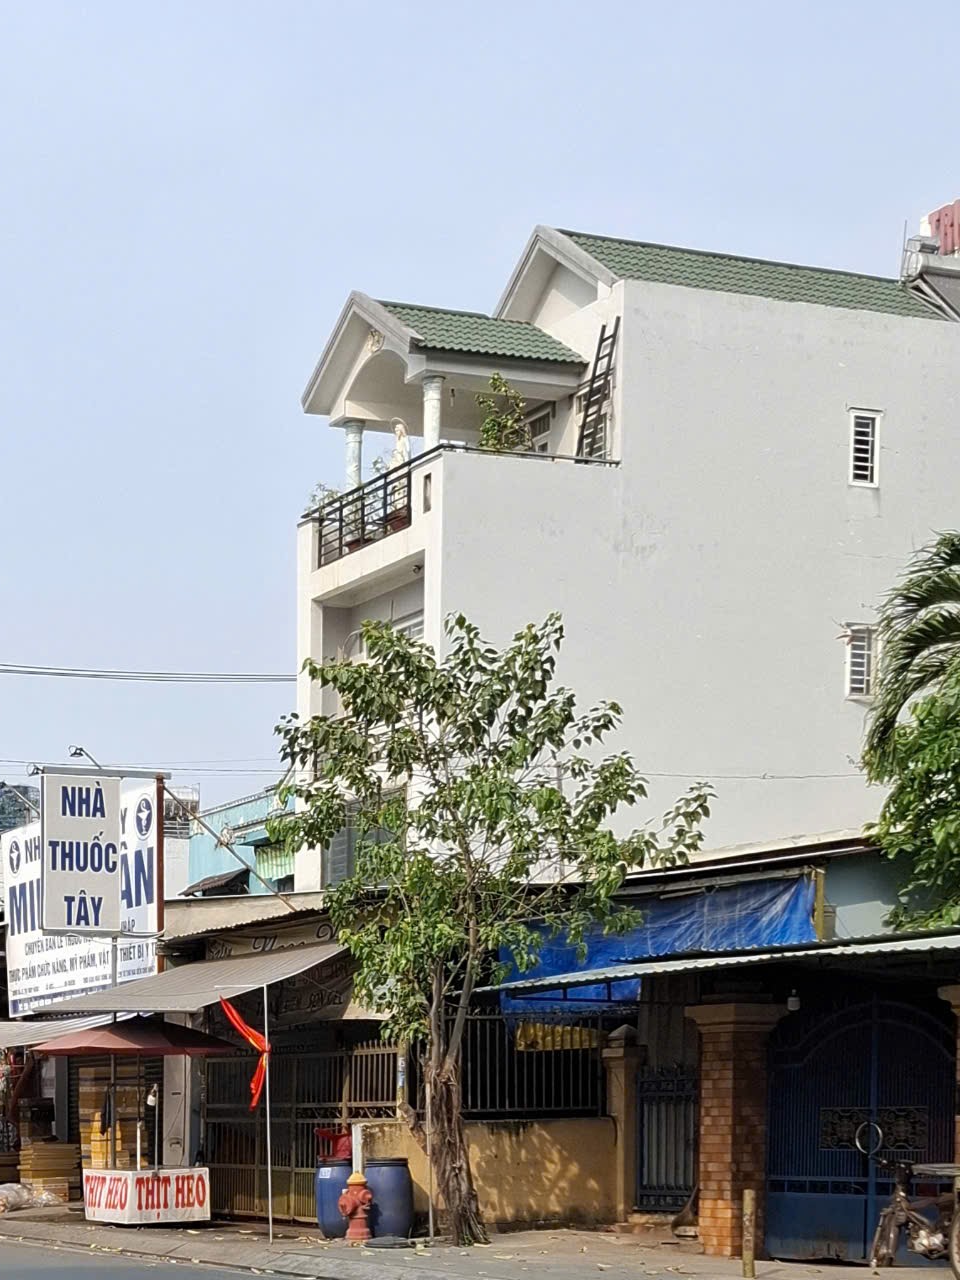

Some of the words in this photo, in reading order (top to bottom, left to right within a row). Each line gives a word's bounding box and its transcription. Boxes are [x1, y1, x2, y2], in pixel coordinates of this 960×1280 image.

[61, 781, 106, 819] NHÀ
[24, 836, 40, 864] NH
[48, 831, 118, 874] THUỐC
[121, 841, 154, 909] ÂN
[9, 878, 40, 937] MI
[64, 889, 103, 926] TÂY
[84, 1174, 107, 1217] THỊT
[105, 1175, 129, 1210] HEO
[135, 1175, 171, 1220] THỊT
[175, 1173, 207, 1209] HEO
